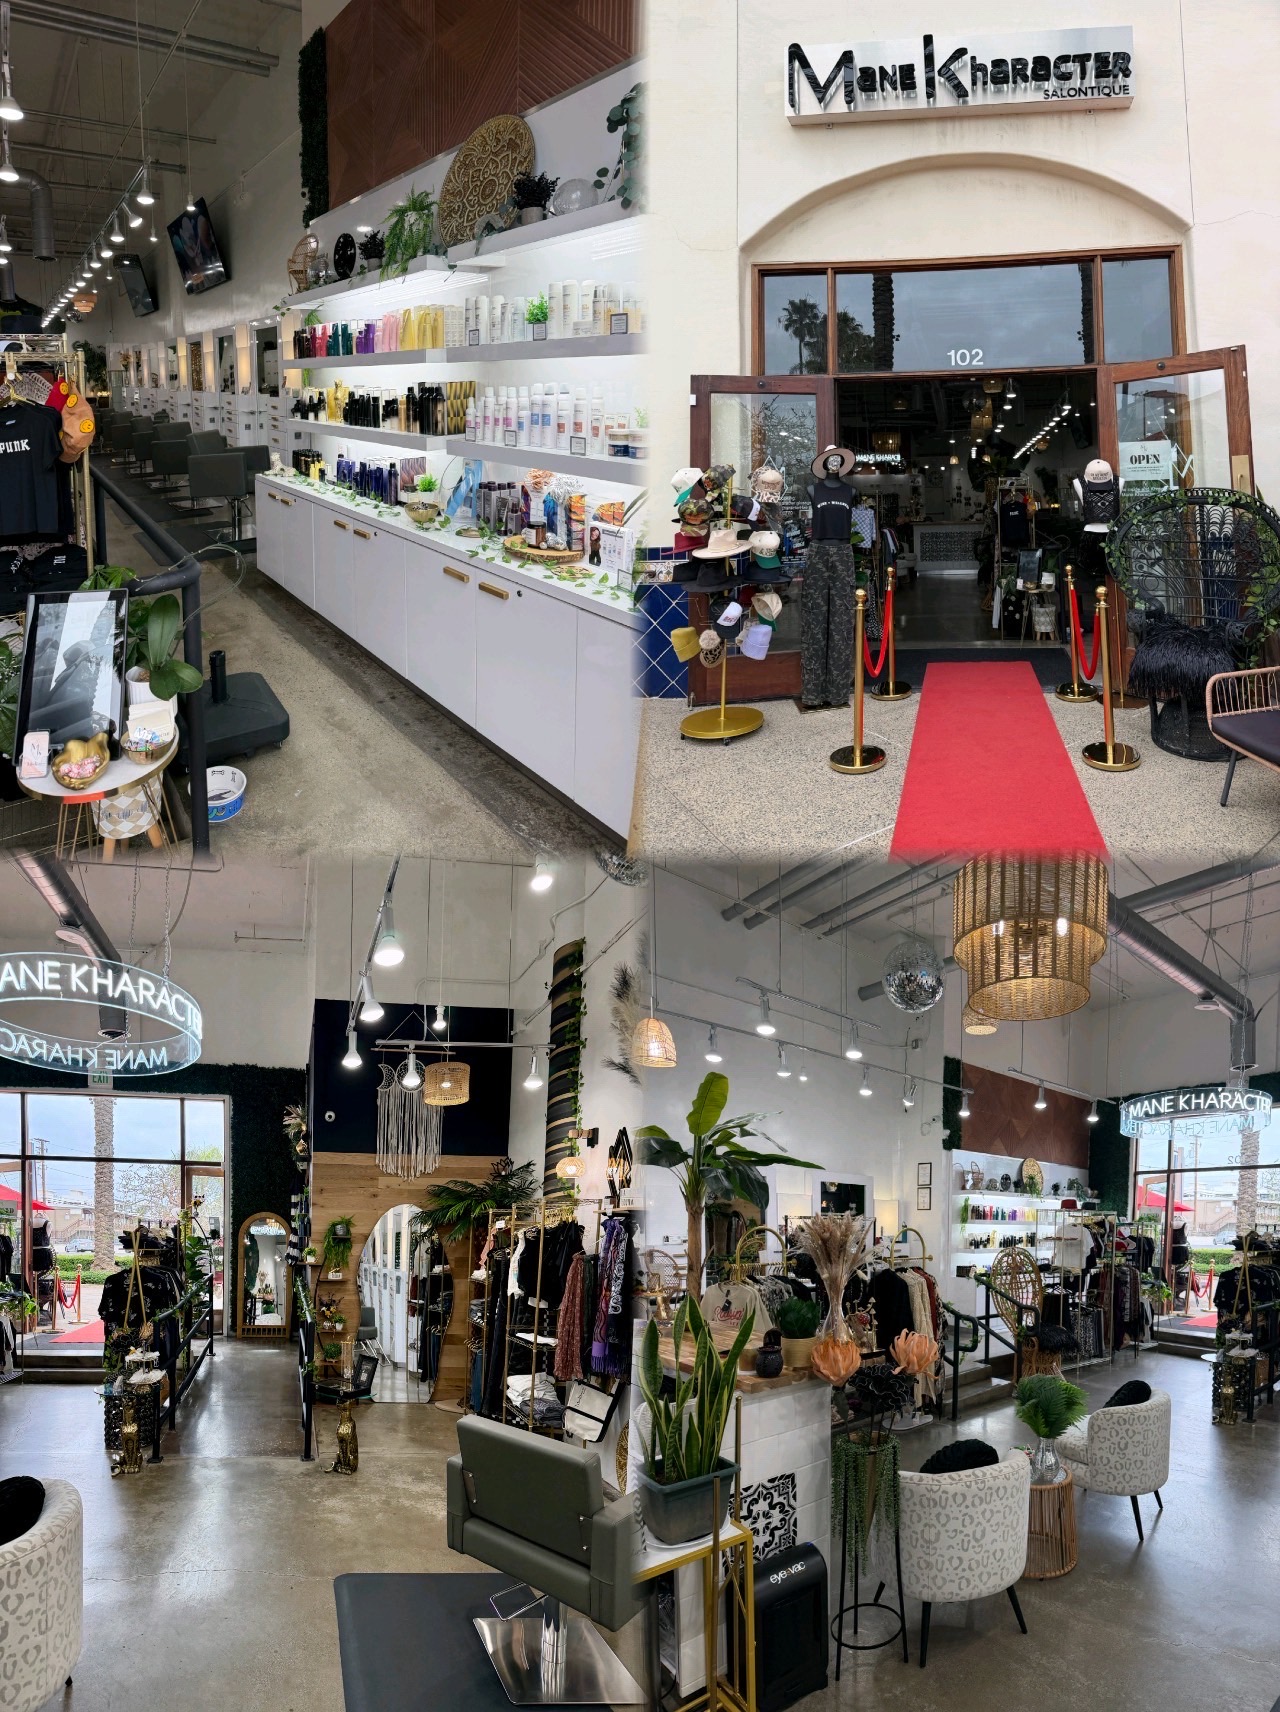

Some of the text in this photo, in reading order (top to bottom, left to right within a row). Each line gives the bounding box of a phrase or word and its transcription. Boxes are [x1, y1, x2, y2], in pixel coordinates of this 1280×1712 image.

[1043, 84, 1131, 100] SALONTIQUE
[946, 348, 984, 366] 102
[1129, 453, 1161, 465] OPEN
[1130, 1096, 1174, 1117] MANE
